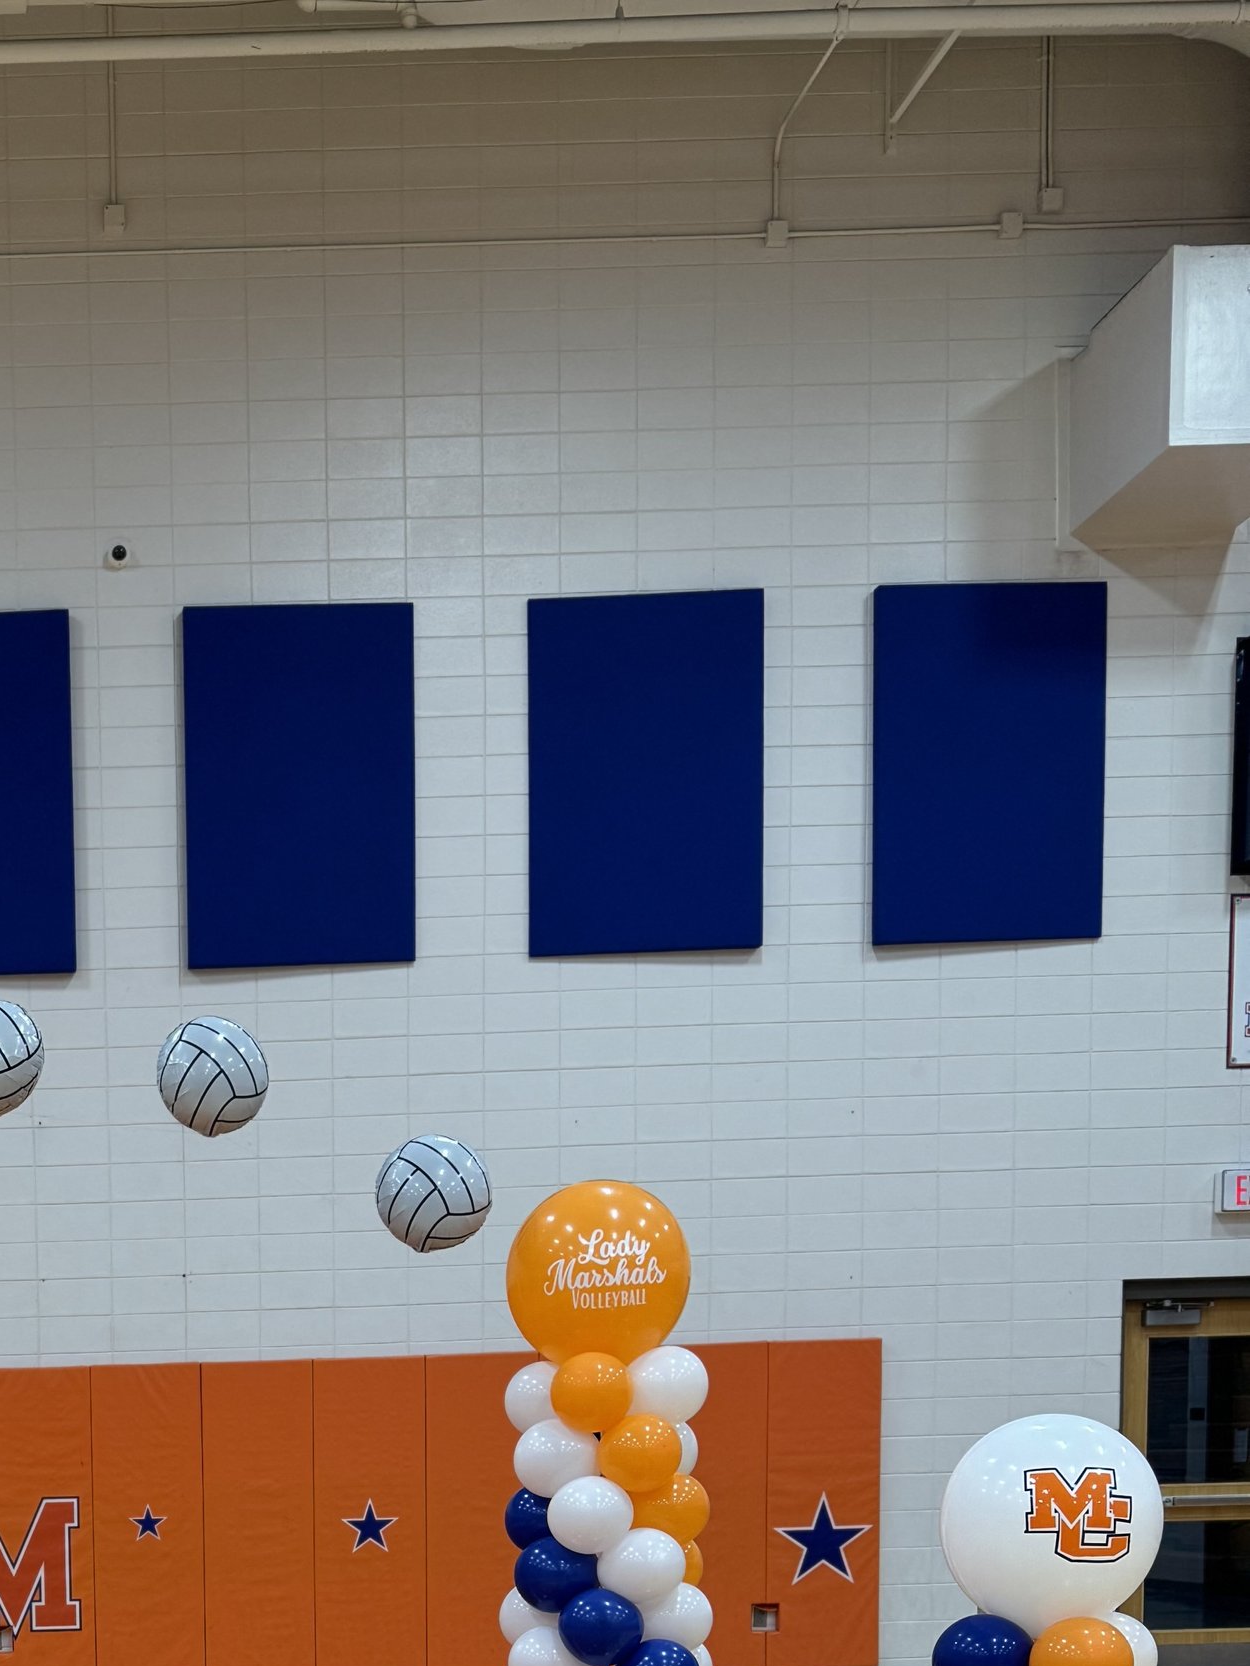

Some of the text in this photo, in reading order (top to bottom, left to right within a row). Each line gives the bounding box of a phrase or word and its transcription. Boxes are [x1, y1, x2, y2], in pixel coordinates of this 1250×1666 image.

[578, 1229, 650, 1265] Lady
[544, 1257, 666, 1295] Marshals
[572, 1288, 646, 1309] VOLLEYBALL
[1024, 1466, 1132, 1563] MC
